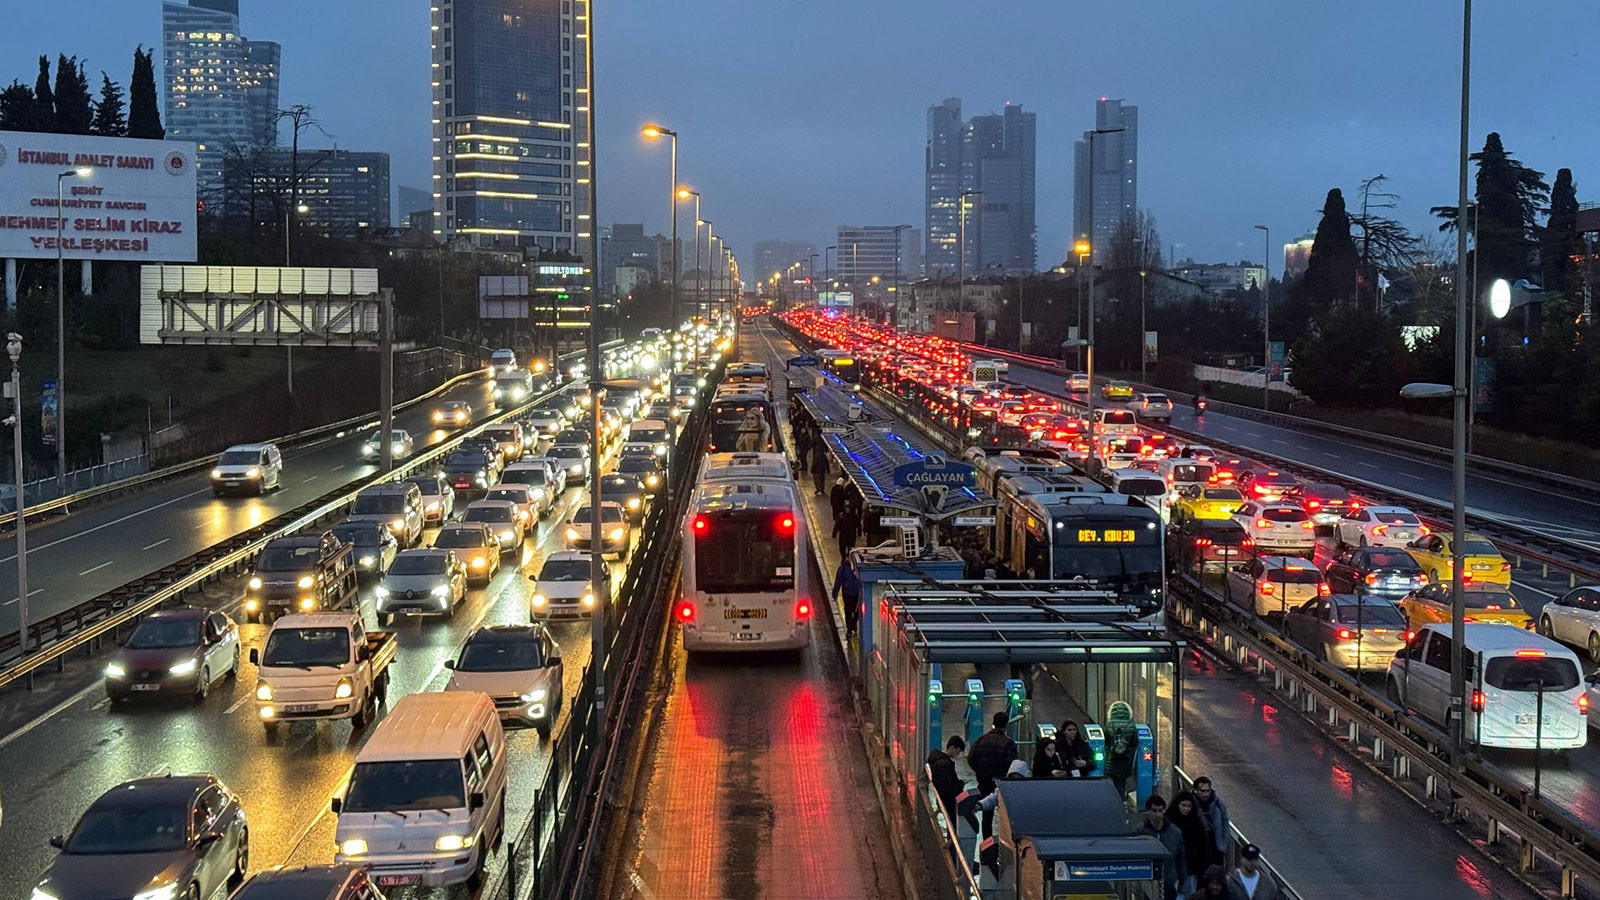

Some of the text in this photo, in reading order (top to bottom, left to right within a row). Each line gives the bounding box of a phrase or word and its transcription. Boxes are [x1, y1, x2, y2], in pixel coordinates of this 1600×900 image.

[18, 148, 154, 170] İSTANBUL ADALET SARAYI
[71, 185, 103, 195] ŞEHİT
[30, 197, 146, 210] CUMHURİYET SAVCISI
[74, 216, 126, 232] SELİM
[131, 218, 182, 234] KİRAZ
[30, 236, 148, 253] YERLEŞKESİ
[907, 472, 964, 485] ÇAĞLAYAN
